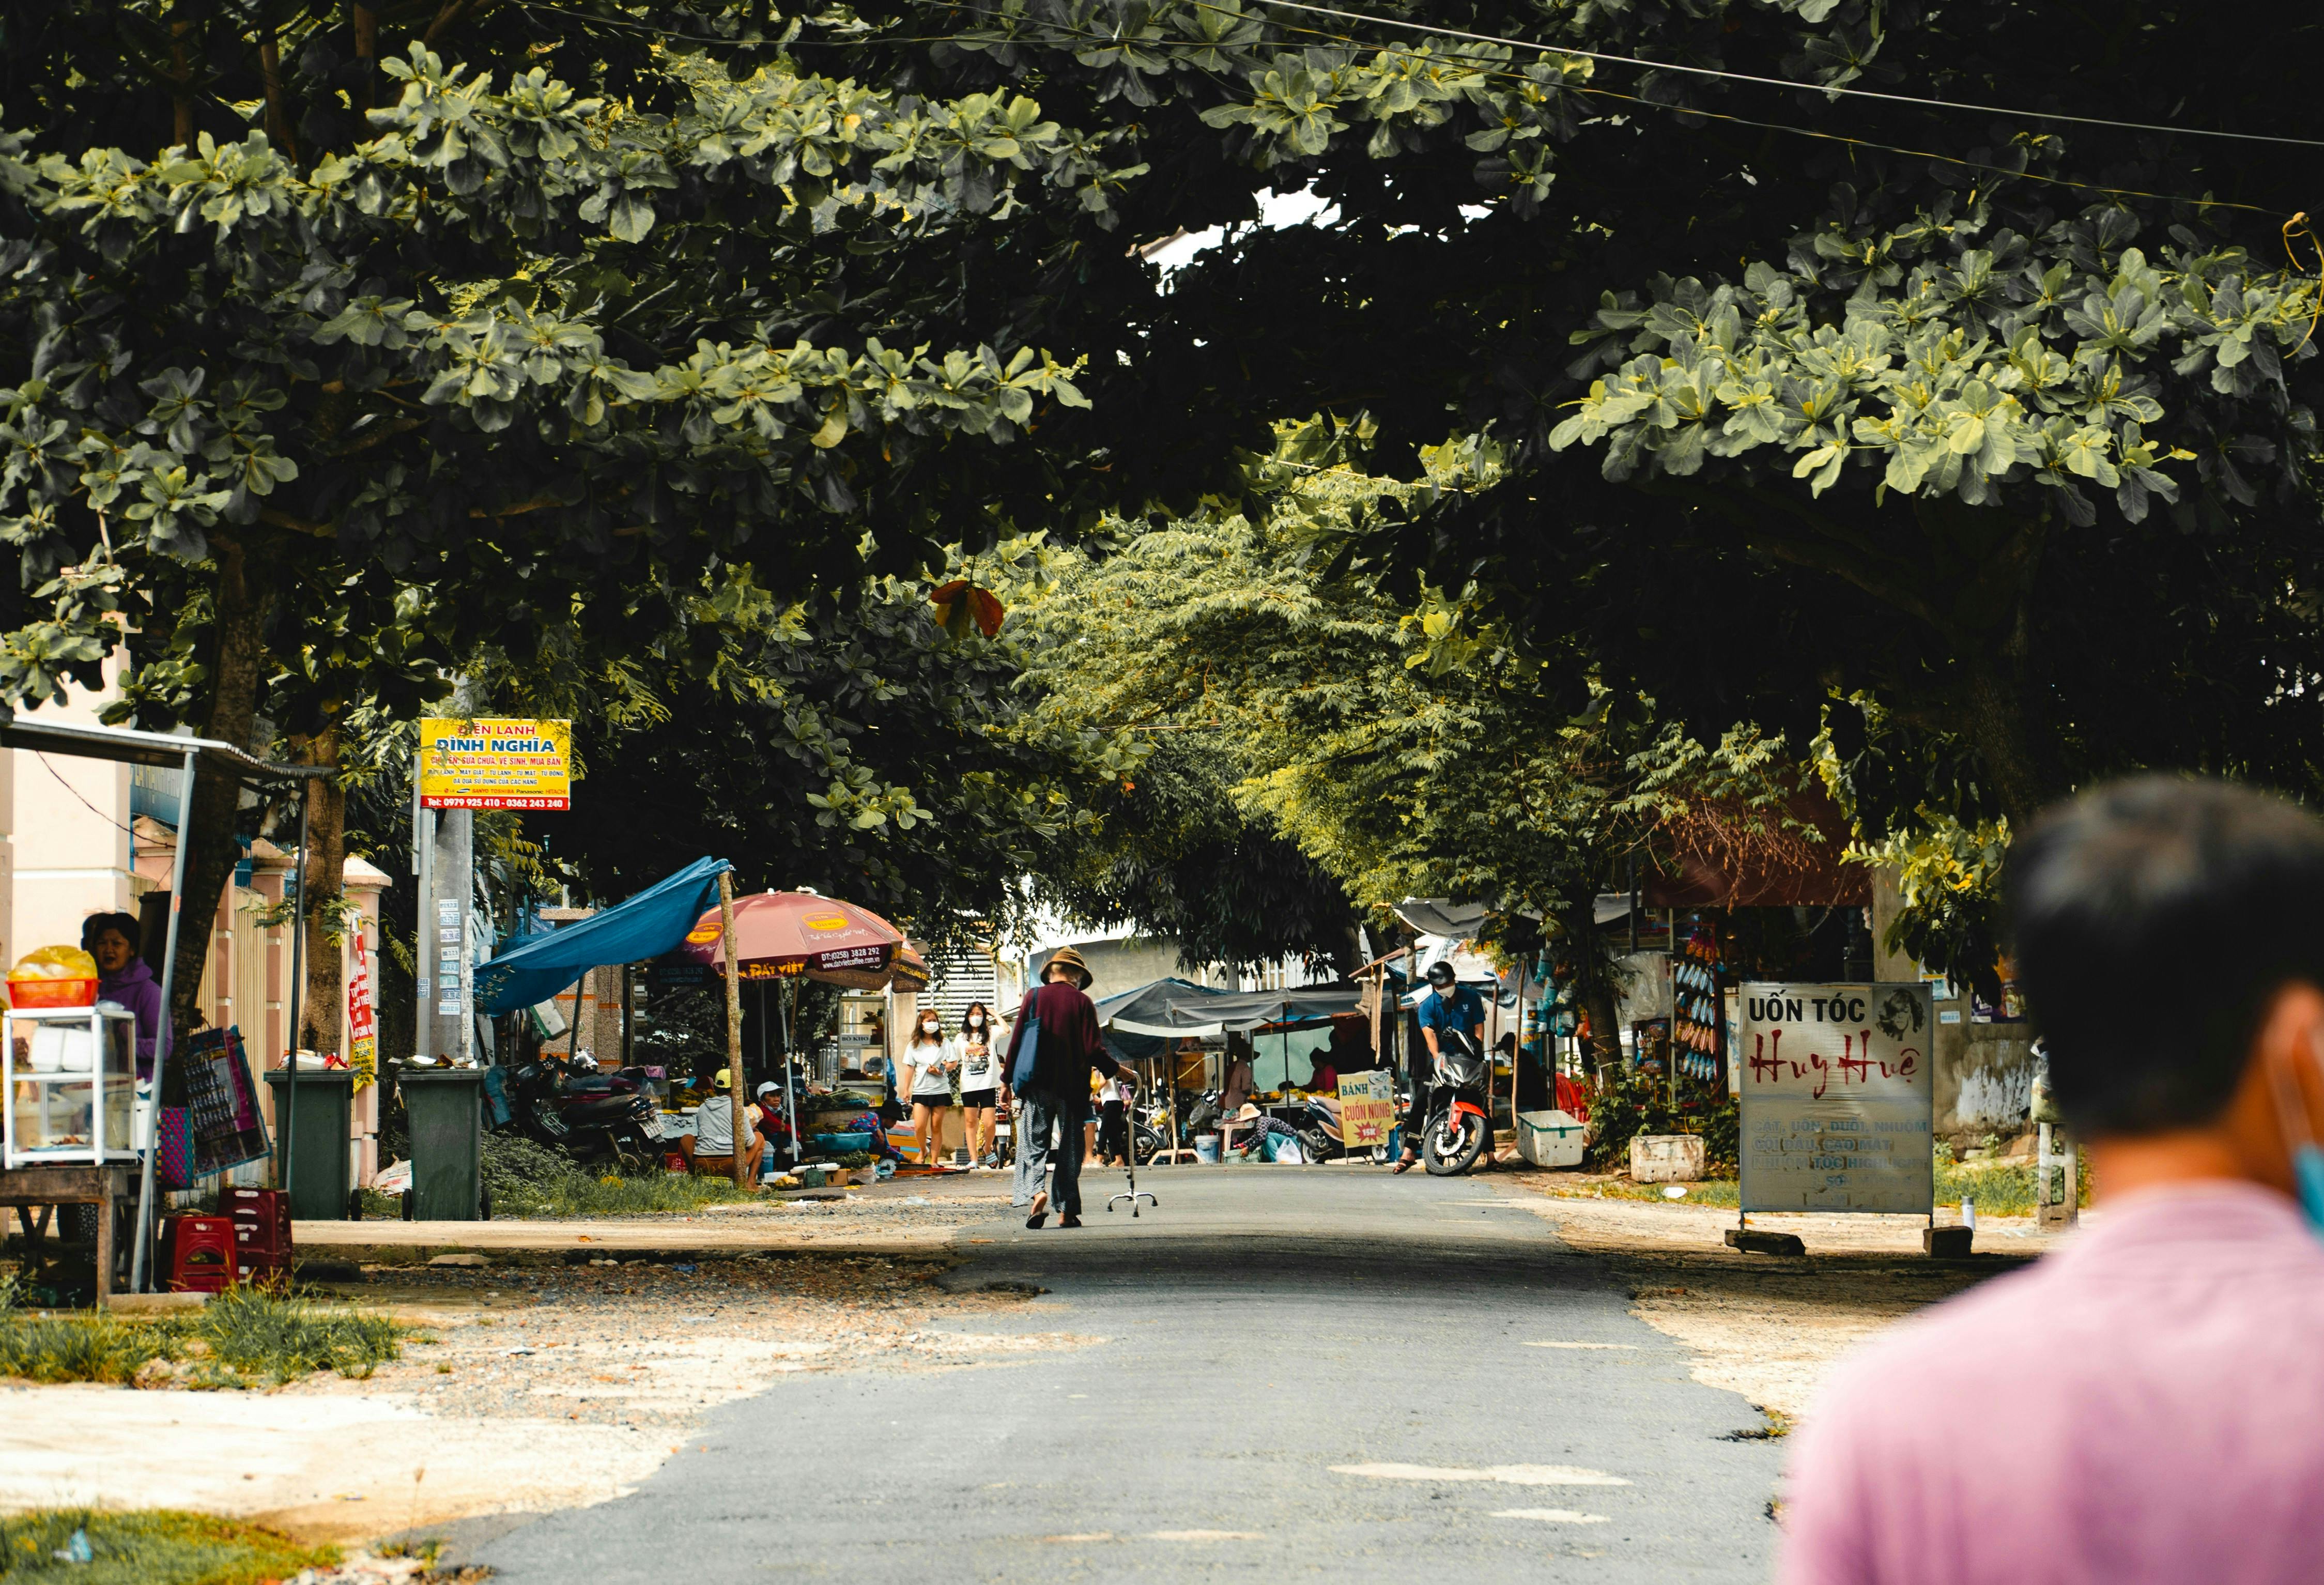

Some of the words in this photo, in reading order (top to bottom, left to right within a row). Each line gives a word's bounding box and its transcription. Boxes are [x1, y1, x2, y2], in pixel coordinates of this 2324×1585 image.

[497, 726, 535, 737] LẠNH
[491, 737, 555, 752] NGHĨA
[547, 757, 561, 765] BÁN
[427, 798, 442, 806] Tel:
[443, 798, 465, 807] 0979
[466, 798, 482, 807] 925
[484, 798, 500, 807] 410
[506, 799, 527, 807] 0362
[529, 799, 545, 808] 243
[547, 799, 563, 808] 240
[851, 949, 867, 957] 3828
[868, 947, 880, 956] 292
[823, 957, 880, 969] www.datvietcoffee.com.vn
[1749, 989, 1803, 1022] UỐN
[1811, 992, 1865, 1023] TÓC
[1342, 1082, 1368, 1096] BÁNH
[1345, 1099, 1366, 1121] CUỐN
[1368, 1100, 1390, 1120] NÓNG
